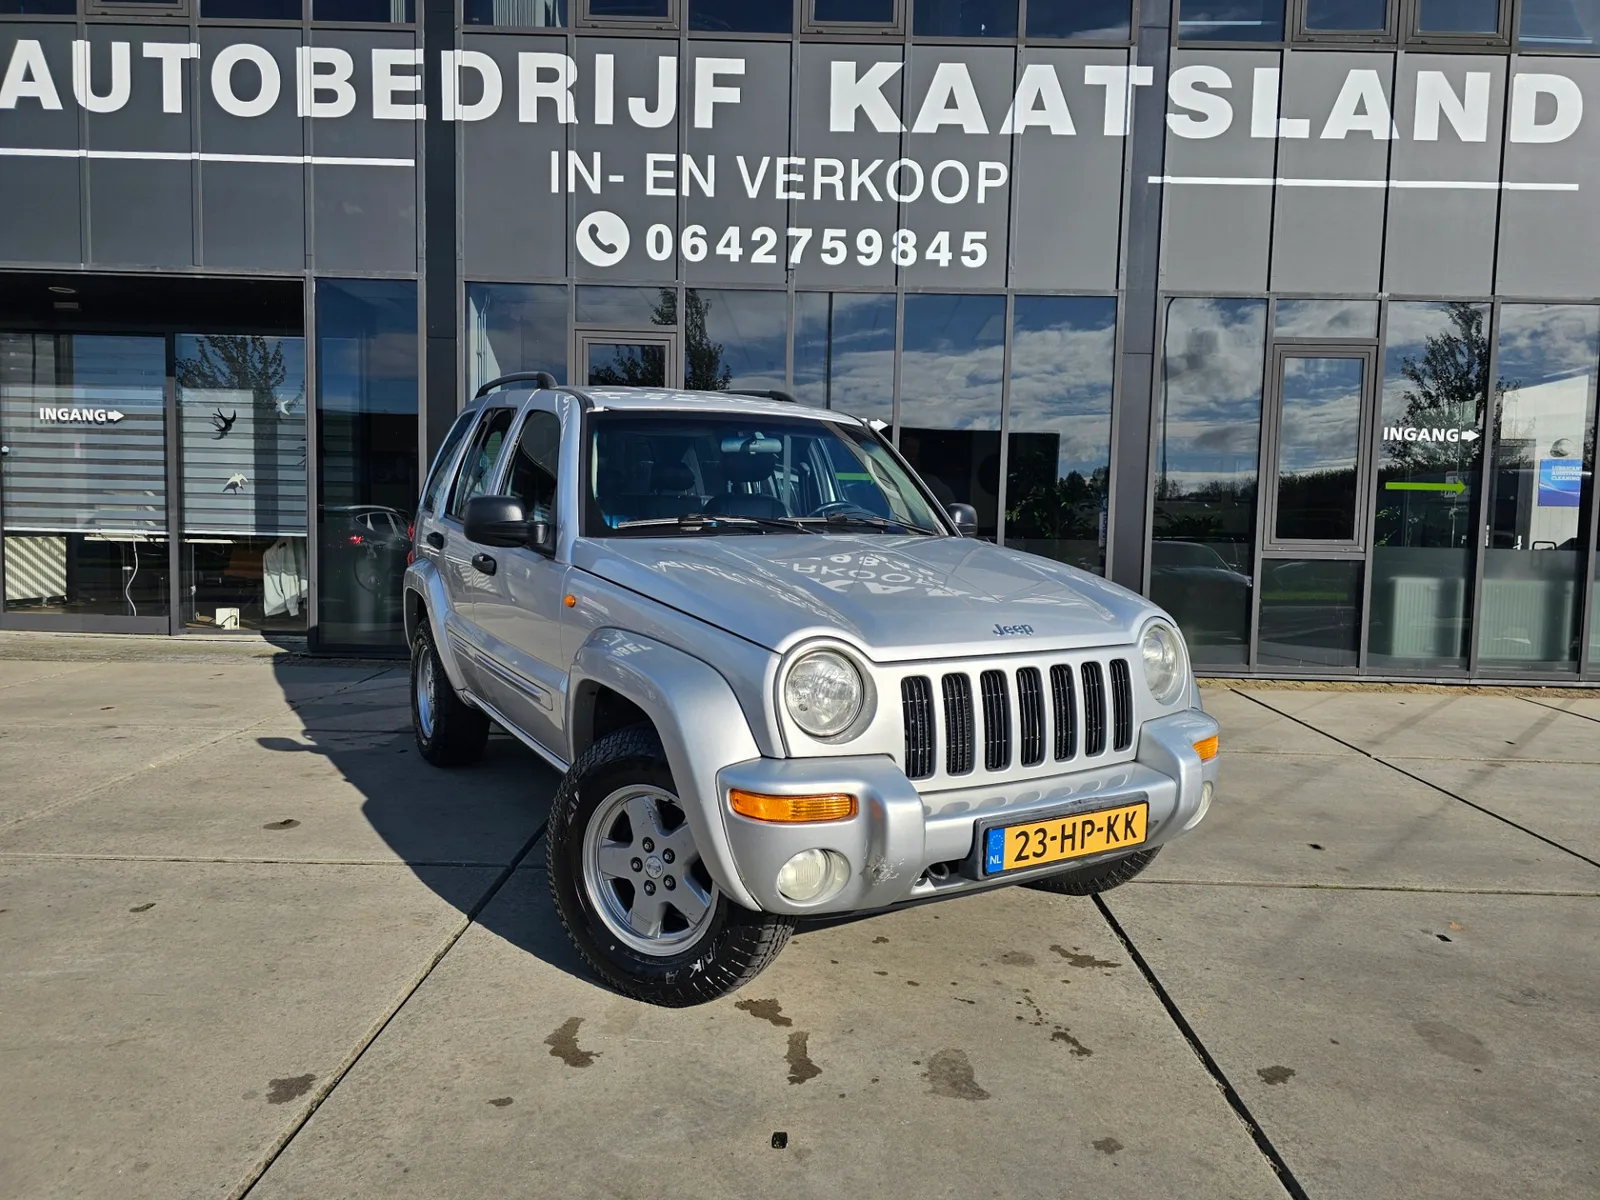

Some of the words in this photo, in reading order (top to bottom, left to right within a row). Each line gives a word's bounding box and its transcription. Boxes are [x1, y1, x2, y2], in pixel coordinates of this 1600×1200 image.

[0, 39, 746, 128] AUTOBEDRIJF
[829, 61, 1584, 143] KAATSLAND
[551, 150, 624, 194] IN-
[645, 153, 716, 198] EN
[736, 156, 1008, 205] VERKOOP
[645, 223, 989, 268] 0642759845
[40, 407, 106, 422] INGANG
[1383, 427, 1459, 442] INGANG
[992, 623, 1034, 636] Jeep
[990, 855, 1001, 864] NL
[1014, 811, 1137, 862] 23-HP-KK
